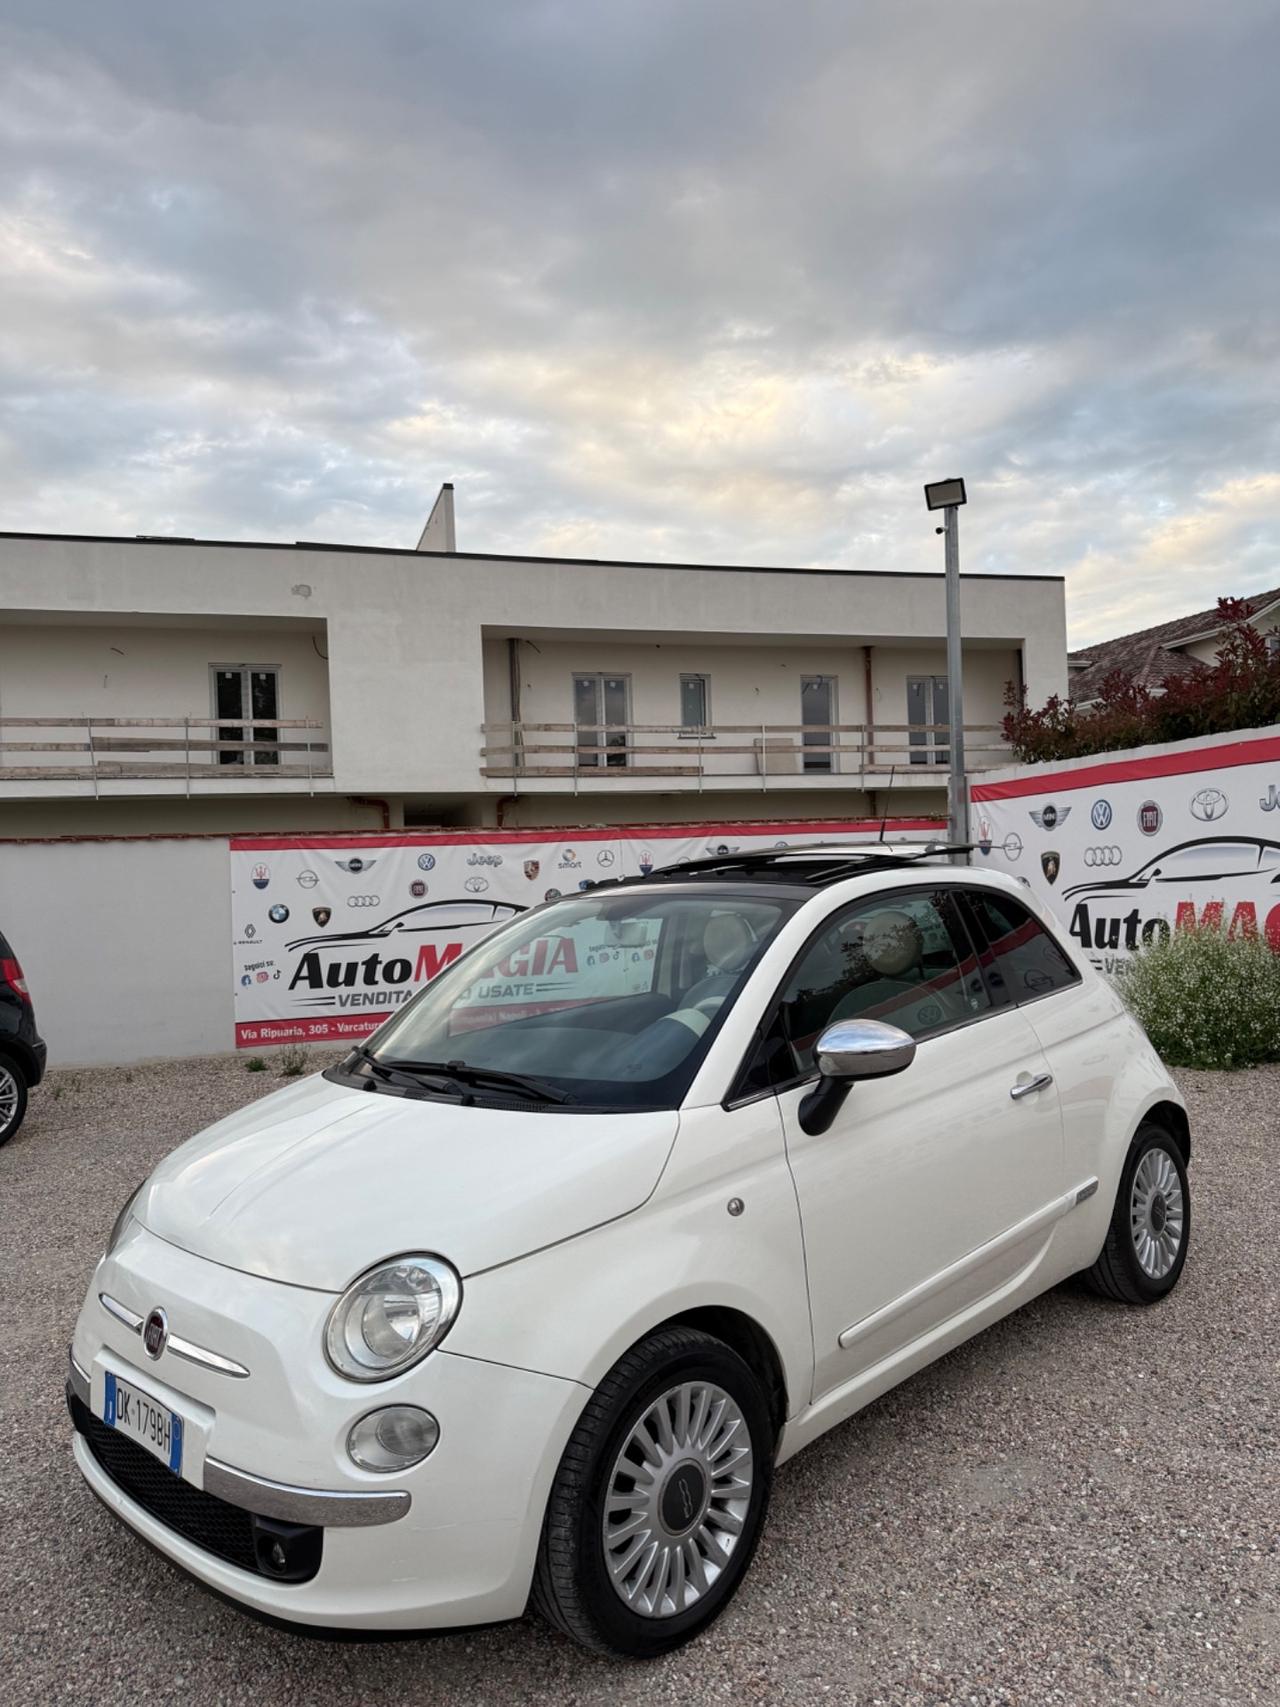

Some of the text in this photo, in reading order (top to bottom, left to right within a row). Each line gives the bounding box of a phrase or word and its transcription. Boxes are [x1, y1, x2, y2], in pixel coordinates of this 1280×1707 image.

[466, 853, 503, 867] Jeep
[478, 983, 535, 999] USATE
[241, 1029, 257, 1039] Via
[260, 1026, 305, 1039] Ripuaria,
[308, 1024, 328, 1034] 305
